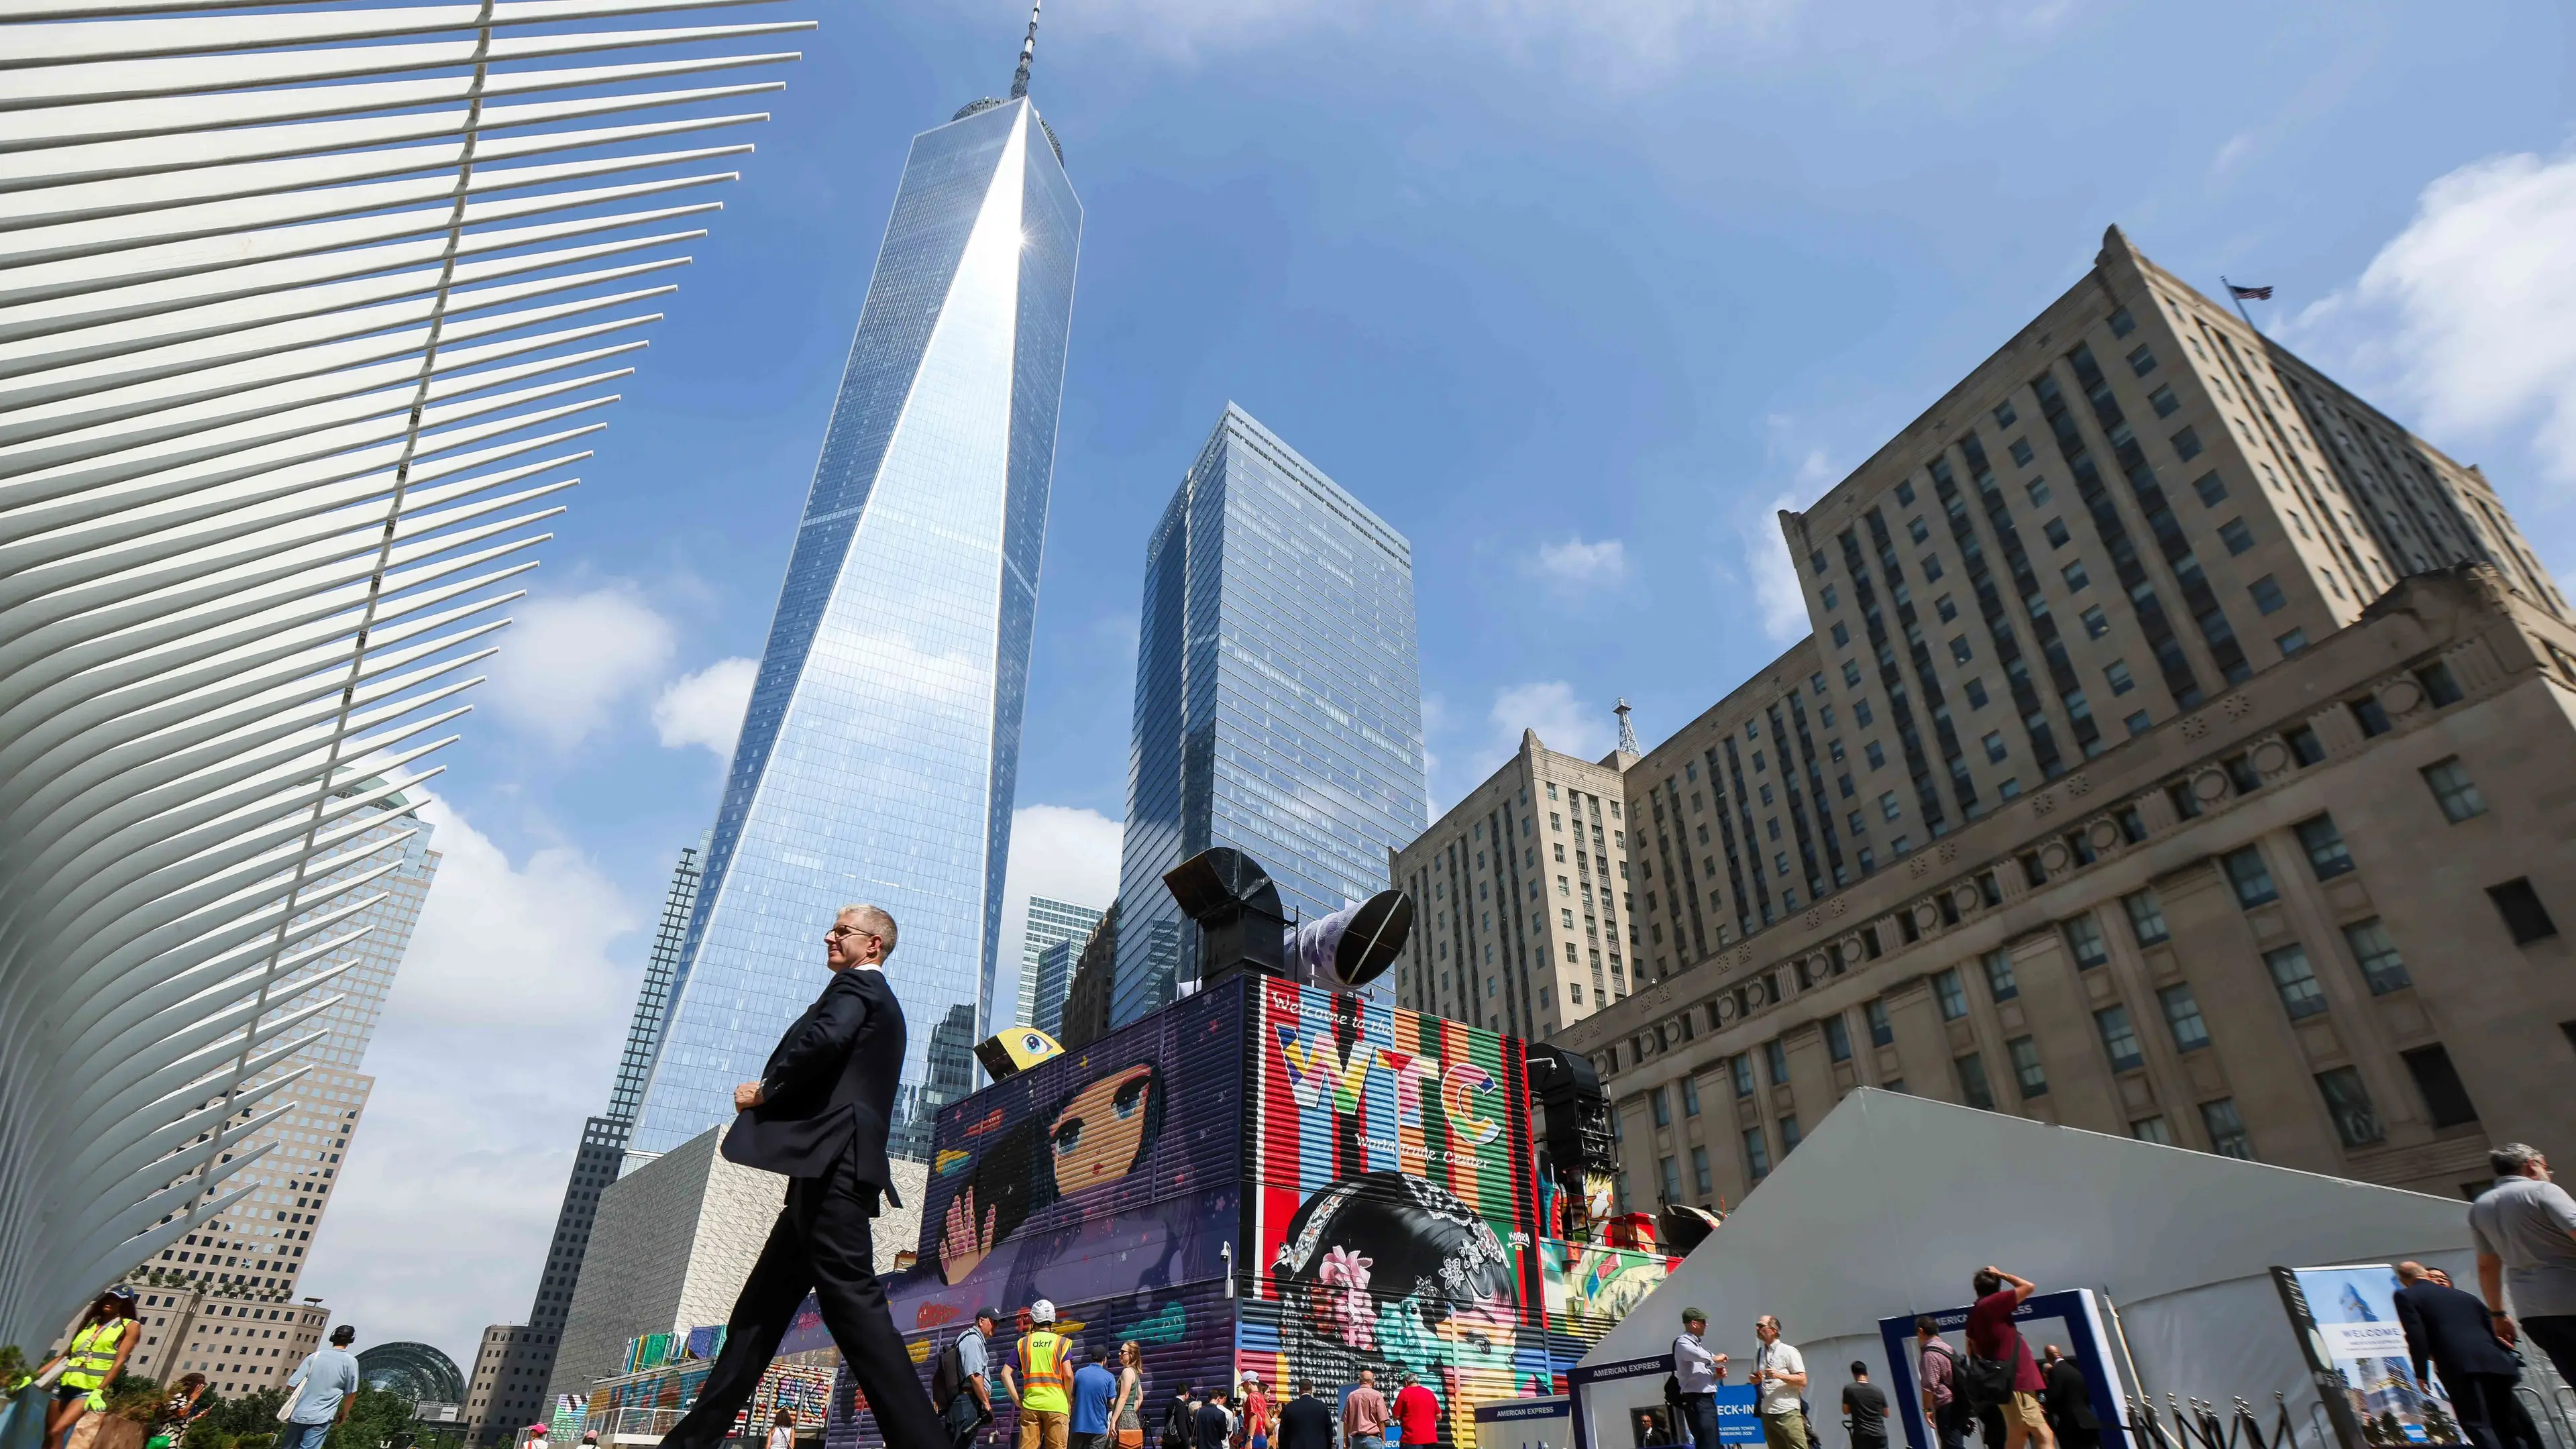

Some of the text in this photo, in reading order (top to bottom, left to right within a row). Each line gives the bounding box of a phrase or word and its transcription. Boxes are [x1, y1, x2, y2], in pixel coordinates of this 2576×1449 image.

[1271, 991, 1348, 1024] Welcome
[1352, 1016, 1364, 1028] to
[1274, 1023, 1501, 1145] WTC
[1443, 1151, 1492, 1169] Center
[1508, 1232, 1530, 1244] KOBRA
[2342, 1328, 2401, 1338] WELCOME
[1593, 1360, 1661, 1377] AMERICAN EXPRESS
[1497, 1407, 1554, 1417] AMERICAN EXPRESS
[1717, 1404, 1755, 1415] ECK-IN
